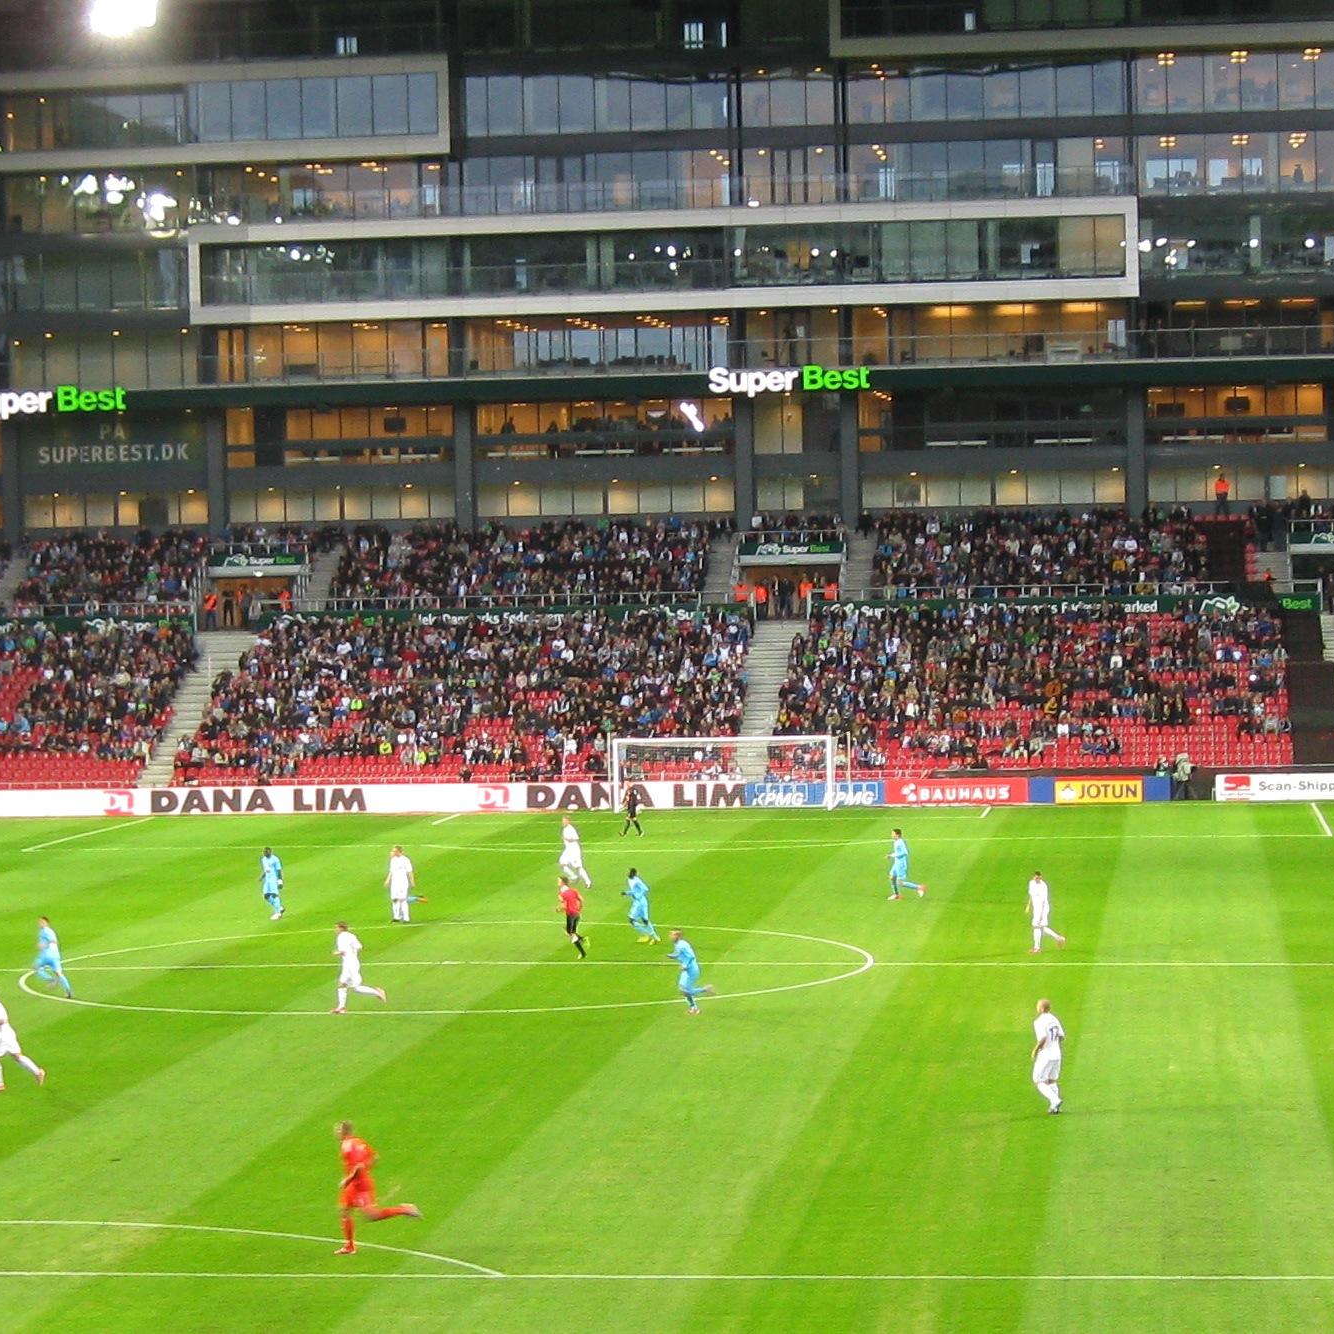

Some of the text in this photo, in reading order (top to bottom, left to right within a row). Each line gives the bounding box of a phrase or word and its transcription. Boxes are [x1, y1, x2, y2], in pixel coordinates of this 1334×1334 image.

[708, 364, 871, 398] Super Best
[56, 384, 127, 413] Best
[38, 442, 191, 465] SUPERBEST.DK
[1281, 597, 1313, 610] Best
[151, 788, 367, 814] DANA LIM
[527, 783, 746, 809] DANA LIM
[920, 784, 1011, 801] BAUHAUS
[1078, 783, 1138, 800] JOTUN
